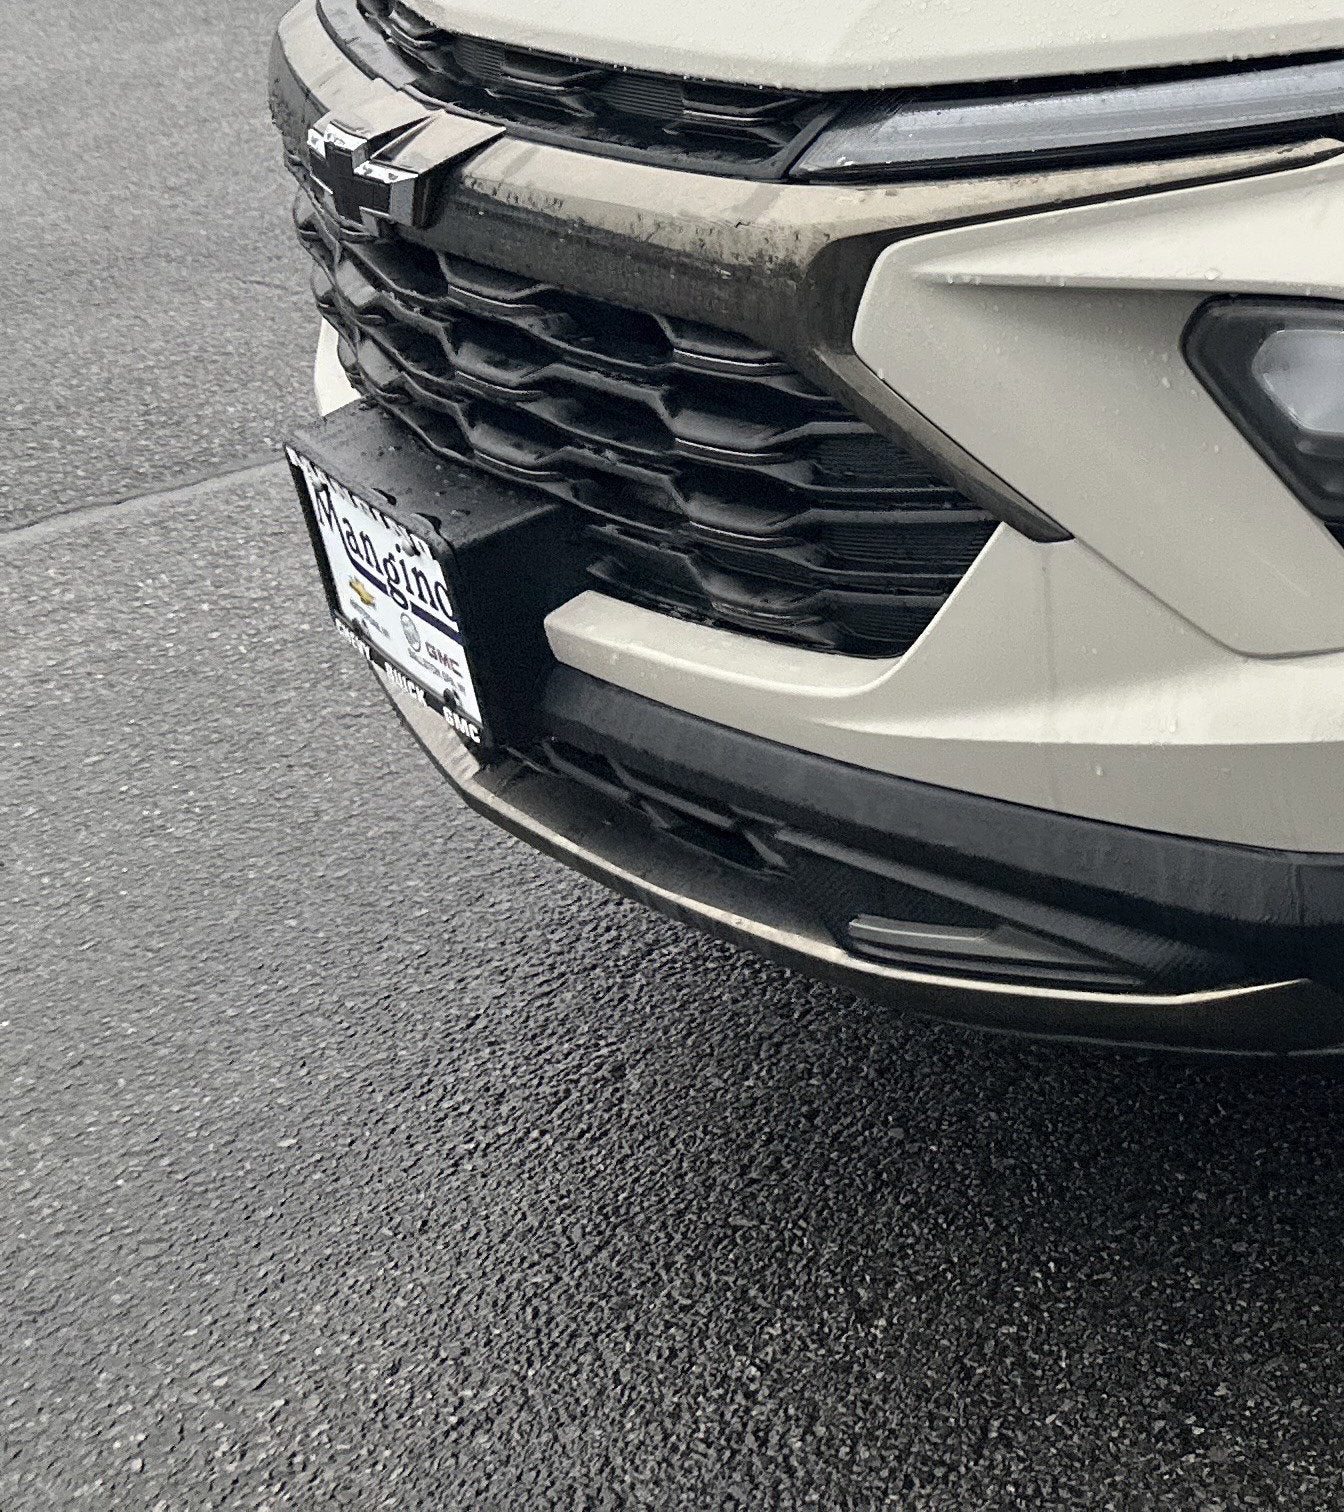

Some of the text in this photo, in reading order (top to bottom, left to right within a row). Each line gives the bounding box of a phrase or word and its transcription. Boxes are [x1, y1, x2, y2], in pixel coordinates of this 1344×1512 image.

[312, 483, 458, 621] Mangino
[425, 641, 463, 678] GMC
[385, 660, 428, 707] BUICK
[443, 705, 481, 743] GMC
